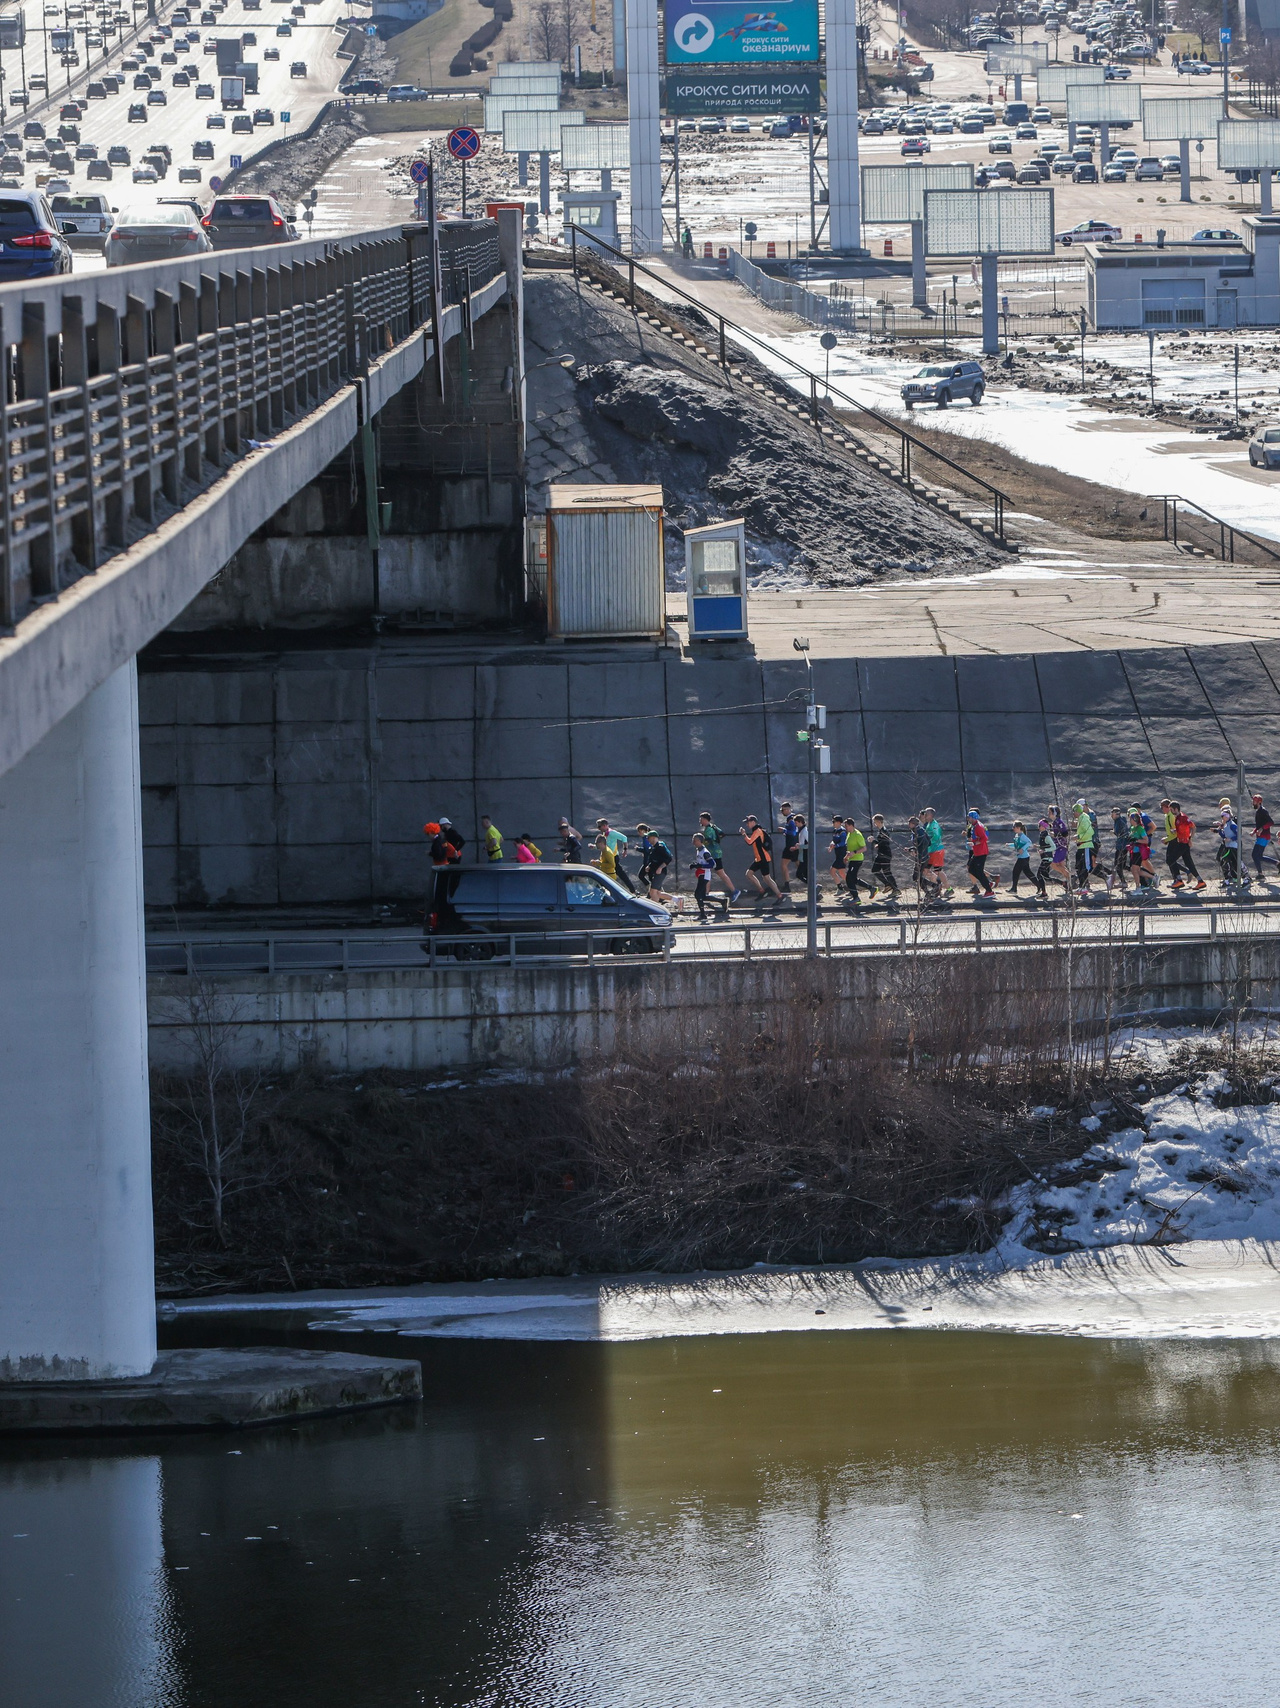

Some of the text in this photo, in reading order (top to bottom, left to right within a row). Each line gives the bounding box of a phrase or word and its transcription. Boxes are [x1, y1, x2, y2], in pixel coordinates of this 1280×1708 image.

[1221, 32, 1231, 40] P1
[742, 37, 769, 45] крокус
[742, 43, 810, 54] океанариум
[676, 84, 810, 96] КРОКУС СИТИ МОЛЛ
